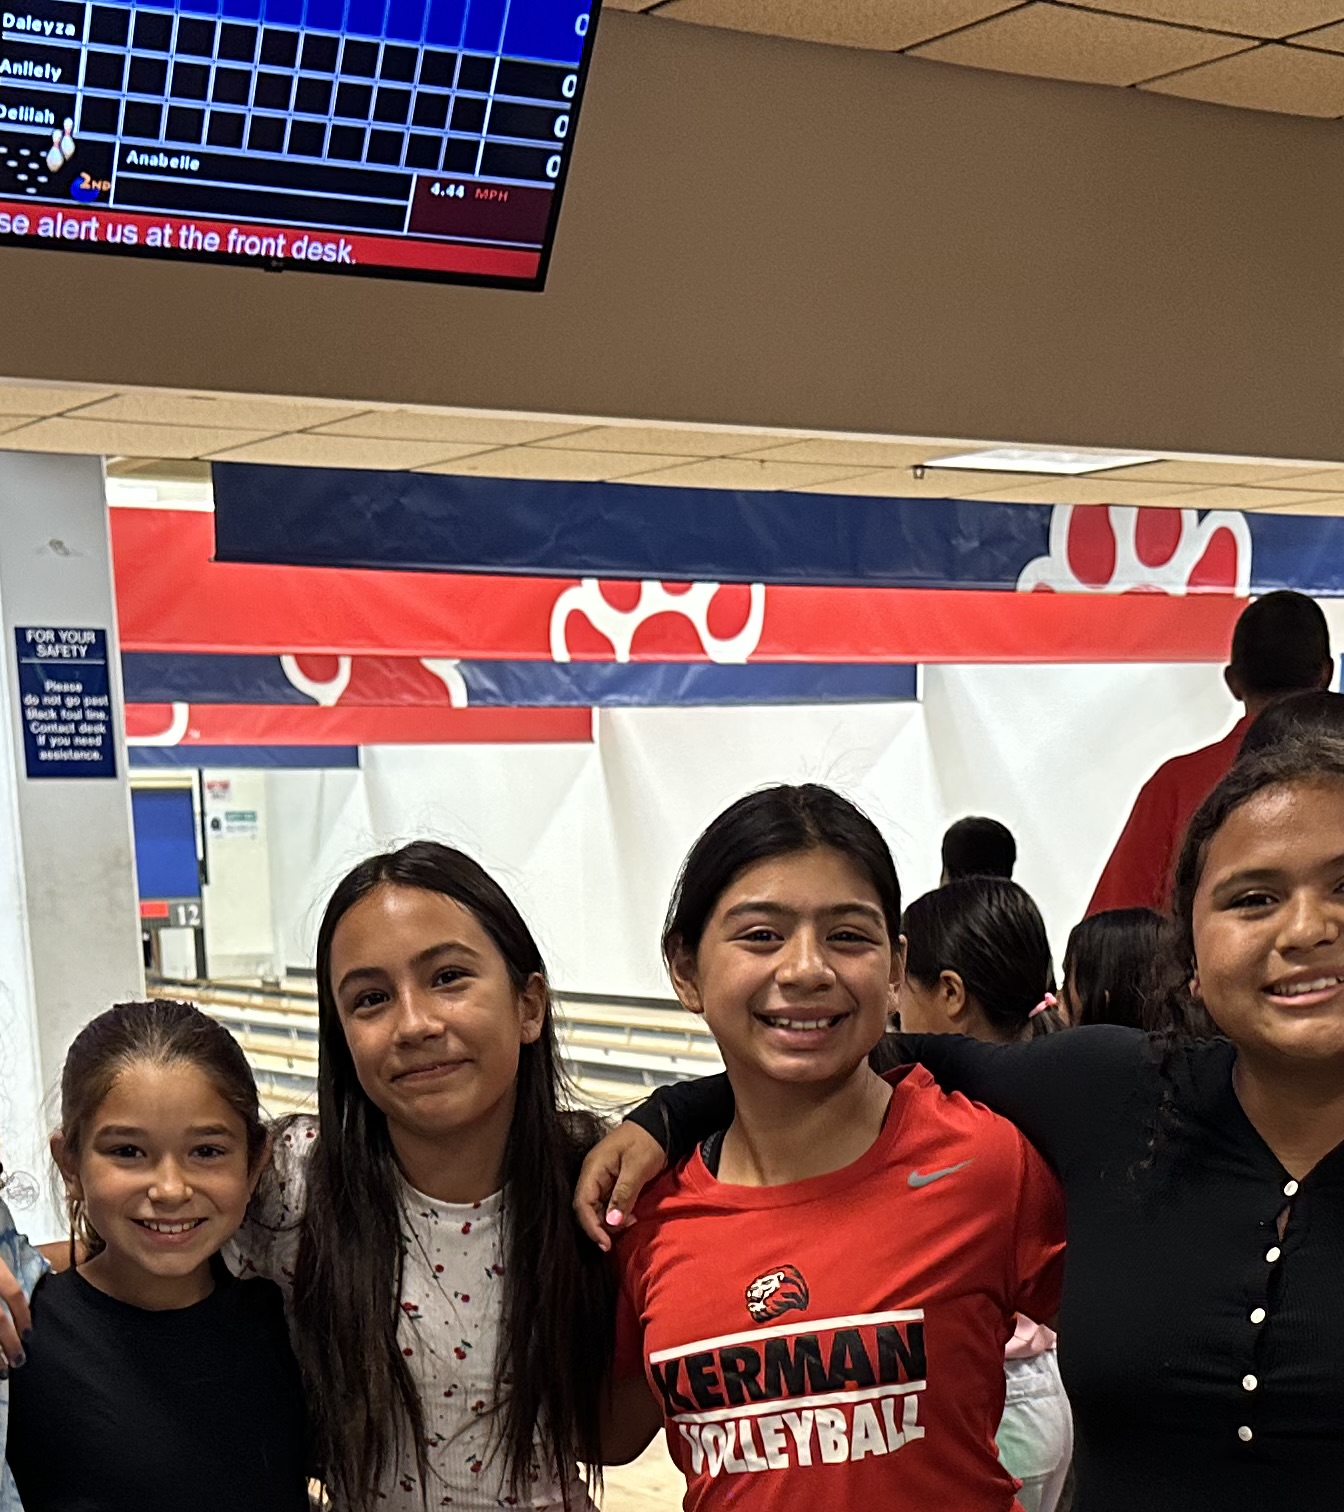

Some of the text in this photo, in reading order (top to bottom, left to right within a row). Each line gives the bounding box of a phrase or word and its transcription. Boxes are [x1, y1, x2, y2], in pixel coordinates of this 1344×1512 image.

[2, 12, 578, 98] Daleyza 0
[553, 115, 569, 138] 0
[126, 150, 200, 171] Anabelle
[545, 155, 561, 178] 0
[430, 182, 509, 202] 4.44 MPH
[37, 212, 99, 241] alert
[106, 223, 138, 245] us
[146, 226, 173, 248] at
[178, 223, 220, 252] the
[227, 228, 285, 258] front
[291, 235, 357, 264] desk.
[25, 629, 96, 645] FOR YOUR
[36, 644, 88, 658] SAFETY
[44, 680, 83, 693] Please
[23, 693, 109, 708] do not go past
[29, 721, 107, 735] Contact desk
[48, 735, 71, 749] you
[73, 735, 102, 747] need
[38, 748, 103, 761] assistance.
[177, 904, 201, 926] 12
[651, 1322, 927, 1416] KERMAN
[679, 1395, 925, 1478] VOLLEYBALL
